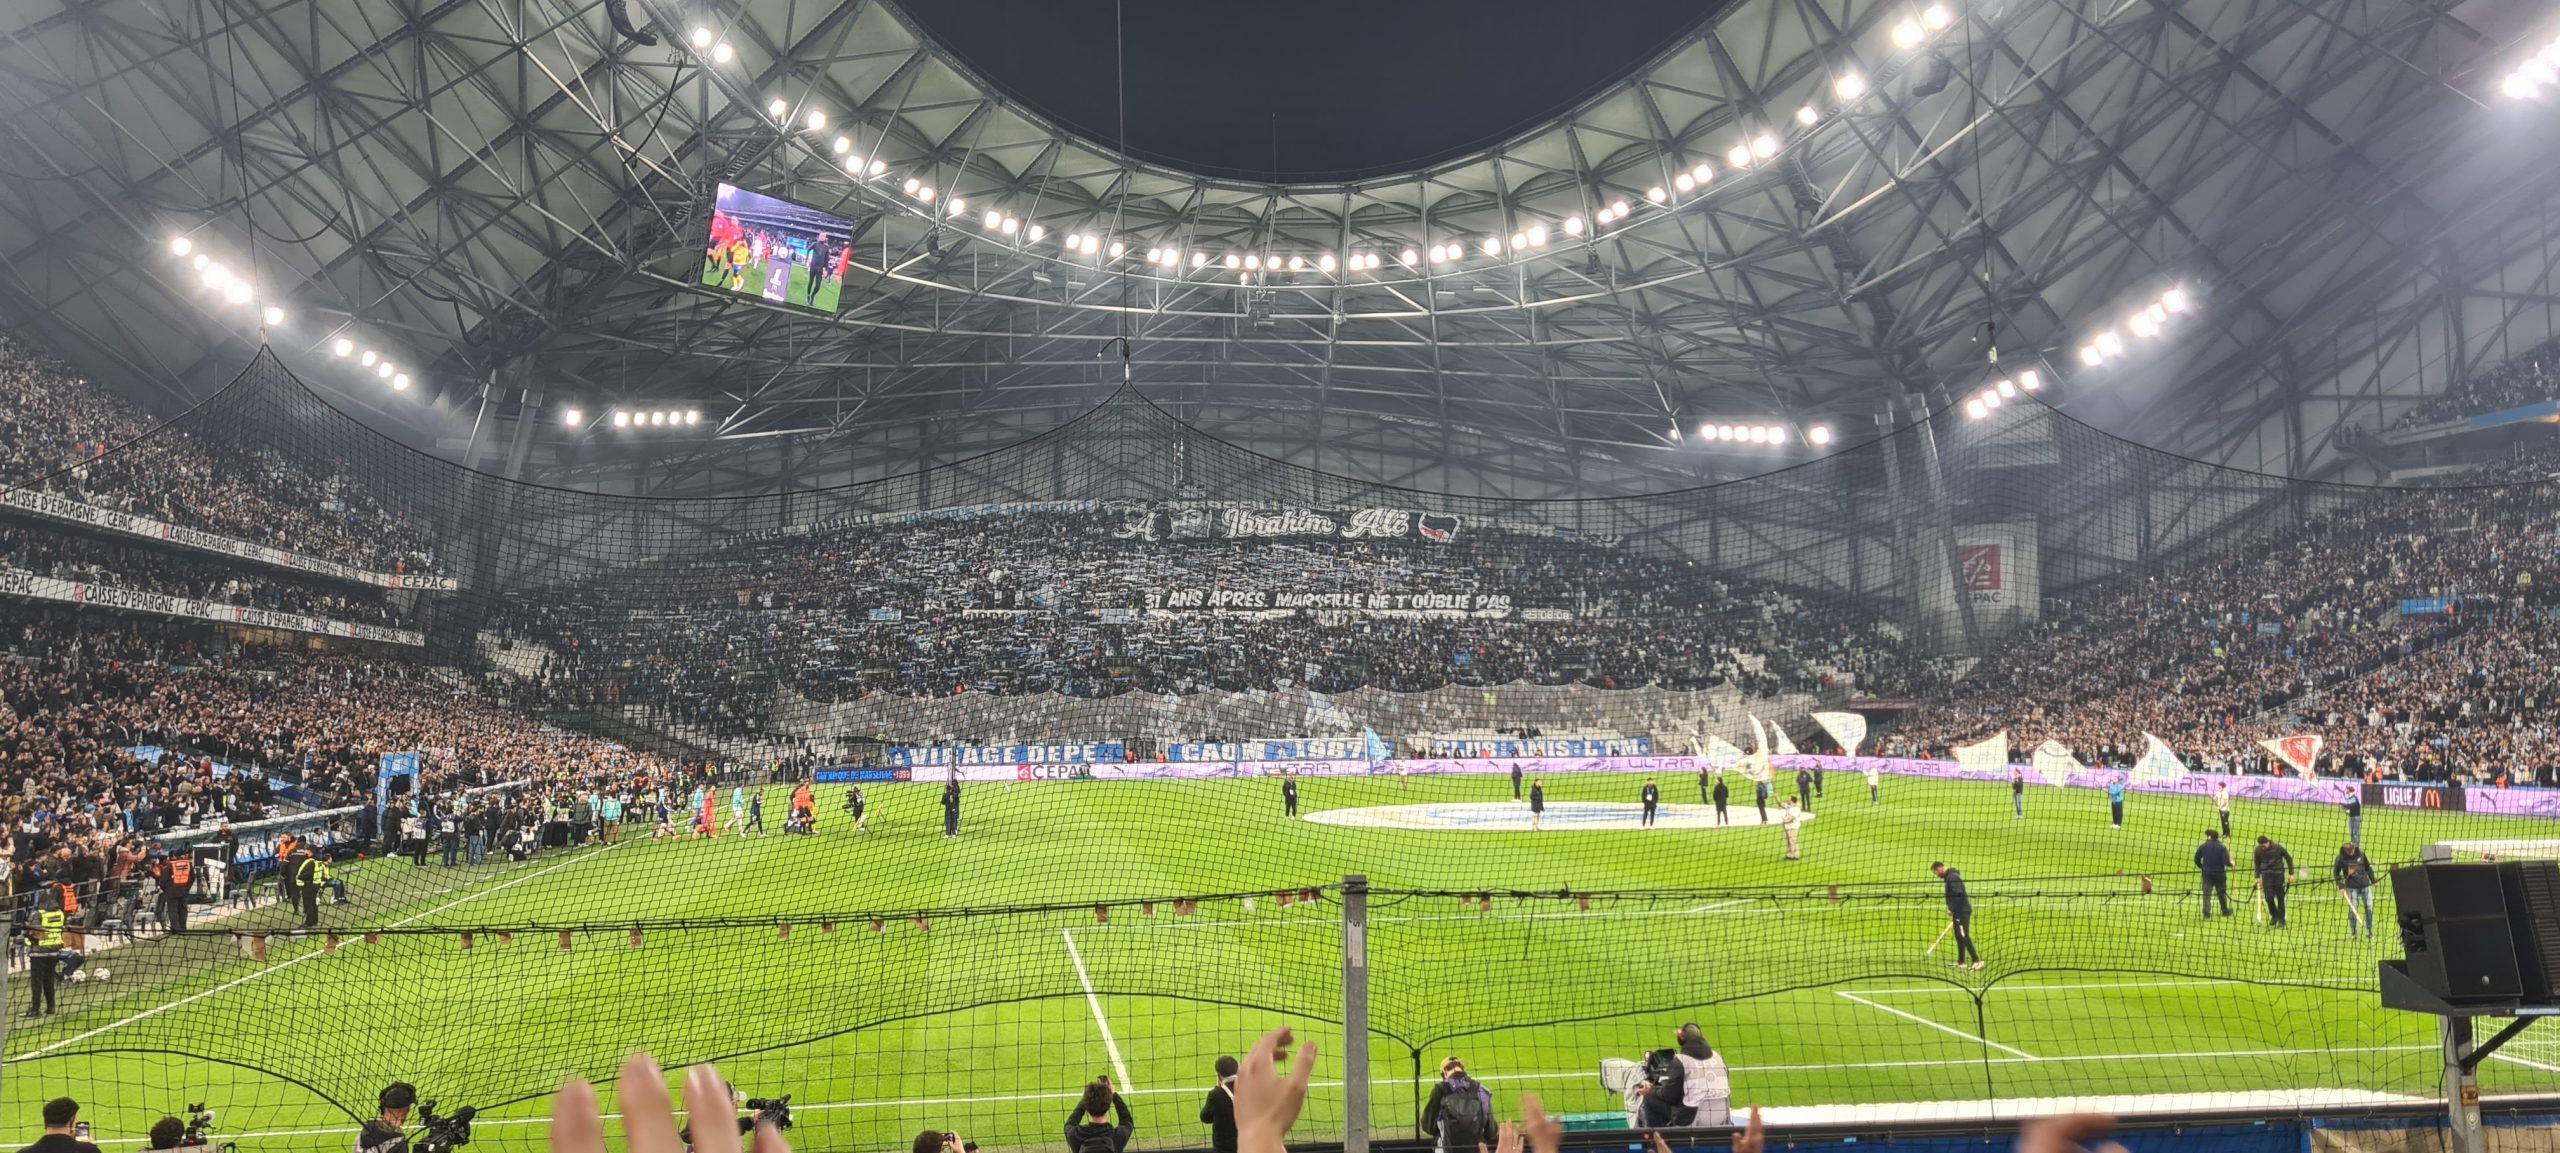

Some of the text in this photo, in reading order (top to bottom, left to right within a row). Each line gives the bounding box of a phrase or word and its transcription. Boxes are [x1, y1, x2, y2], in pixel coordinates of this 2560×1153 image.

[4, 488, 134, 530] CAISSE D'EPARGNE CEPAC
[1222, 508, 1336, 538] Ibrahim
[1341, 508, 1410, 537] Ali
[403, 577, 448, 589] CEPAC
[85, 585, 210, 617] CAISSE D'EPARGNE CEPAC
[1167, 591, 1203, 607] ANS
[1368, 594, 1391, 609] NE
[1476, 594, 1512, 609] PAS
[241, 609, 265, 624] CAISSE
[267, 613, 305, 630] D'EPARGNE
[1033, 764, 1090, 779] CEPA
[1629, 758, 1695, 768] ULTRA
[1903, 761, 1940, 774] ULTRA
[2384, 786, 2413, 806] LIGUE
